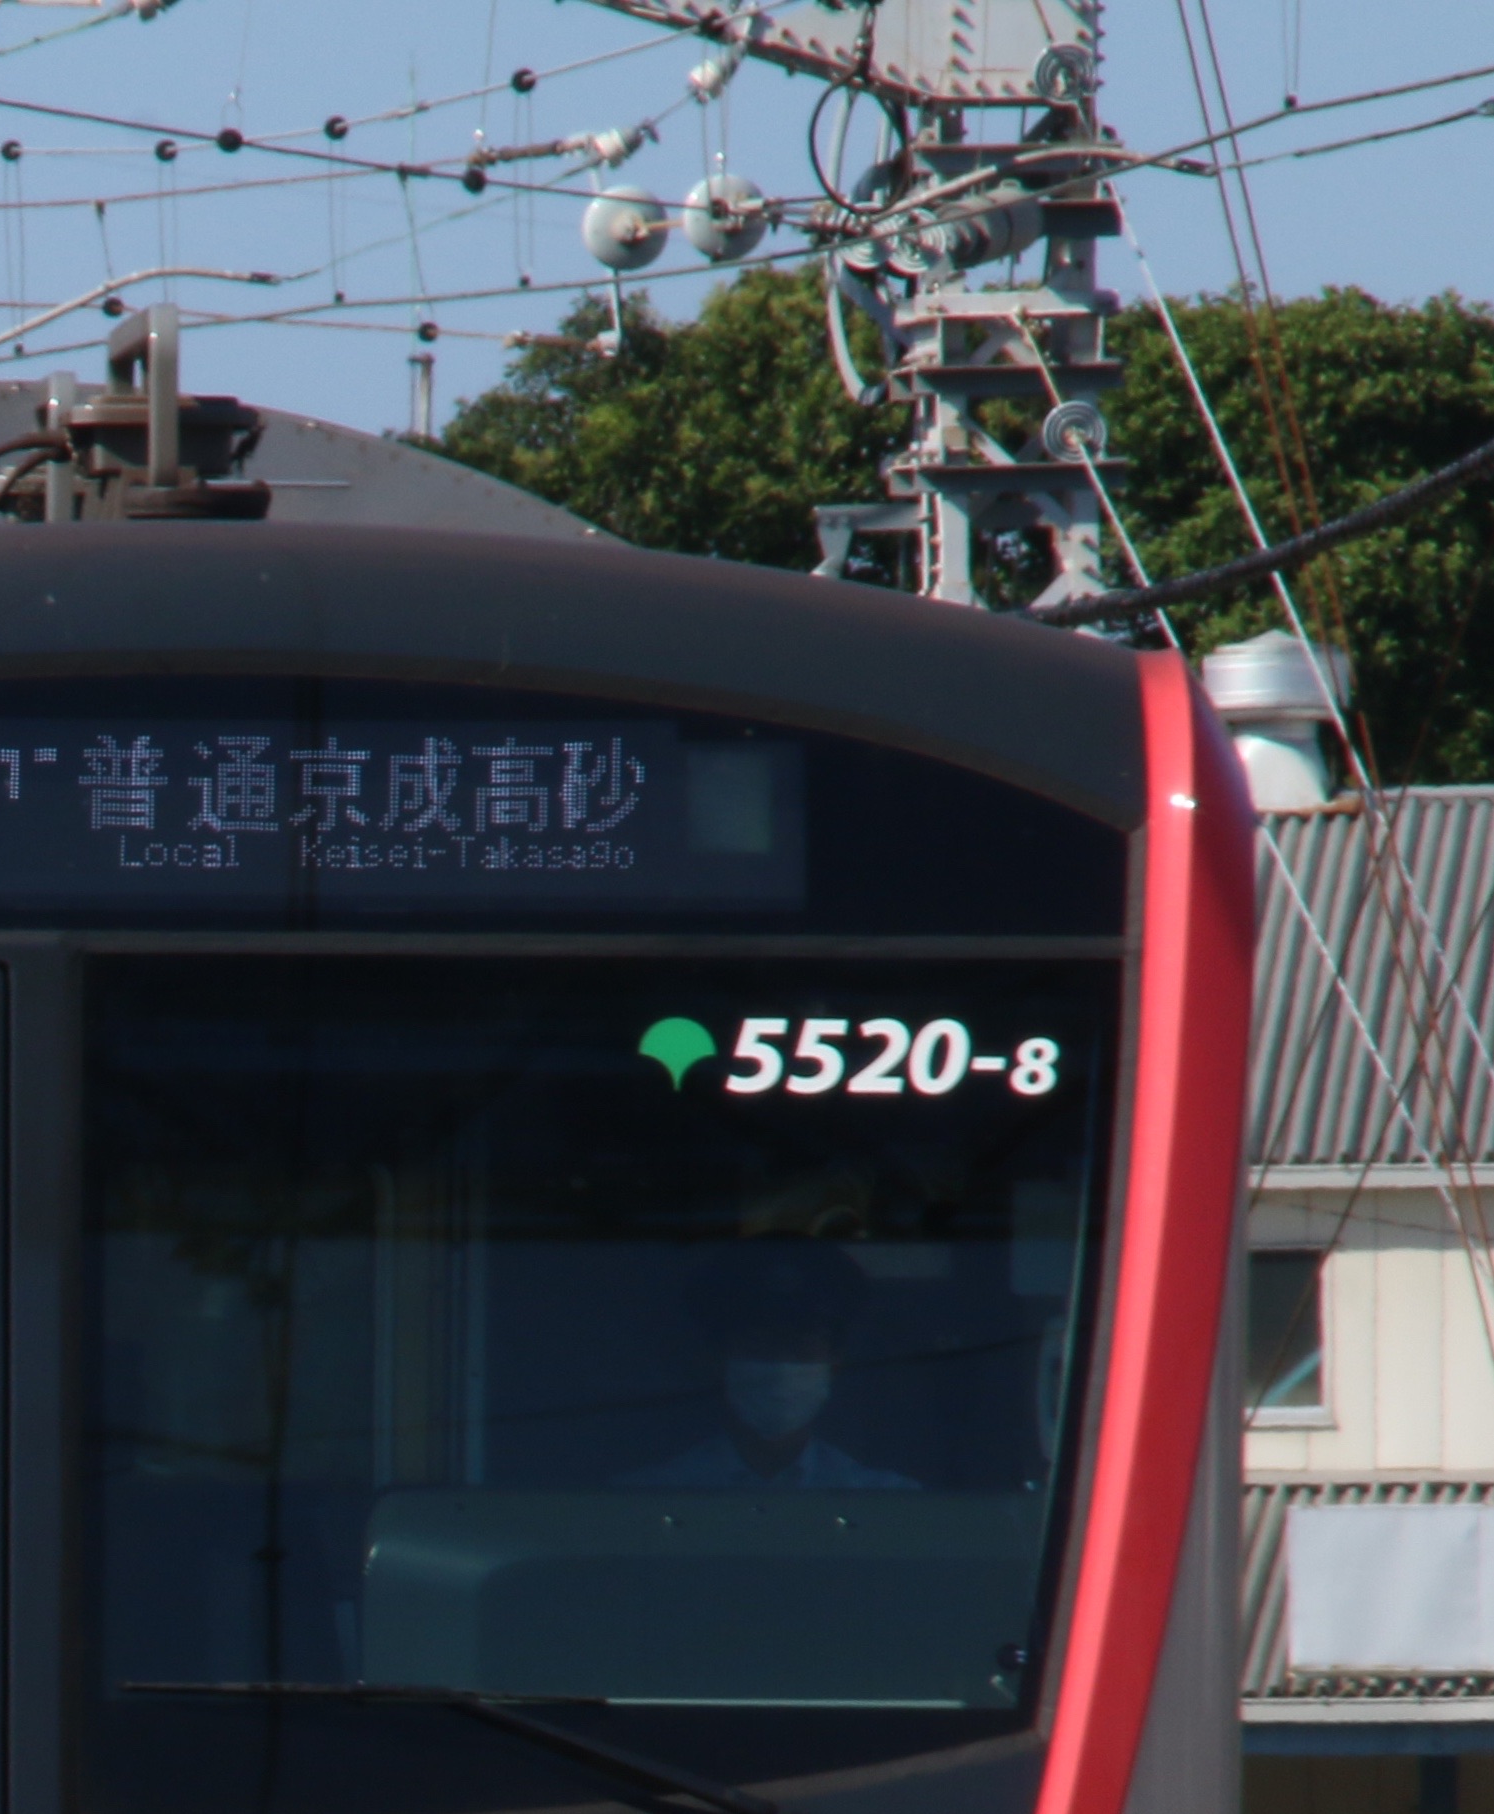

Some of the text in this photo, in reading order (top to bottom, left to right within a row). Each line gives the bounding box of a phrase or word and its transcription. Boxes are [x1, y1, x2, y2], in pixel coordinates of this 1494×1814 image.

[120, 835, 634, 868] Local Keisei-Takasago
[724, 1017, 1060, 1095] 5520-8
